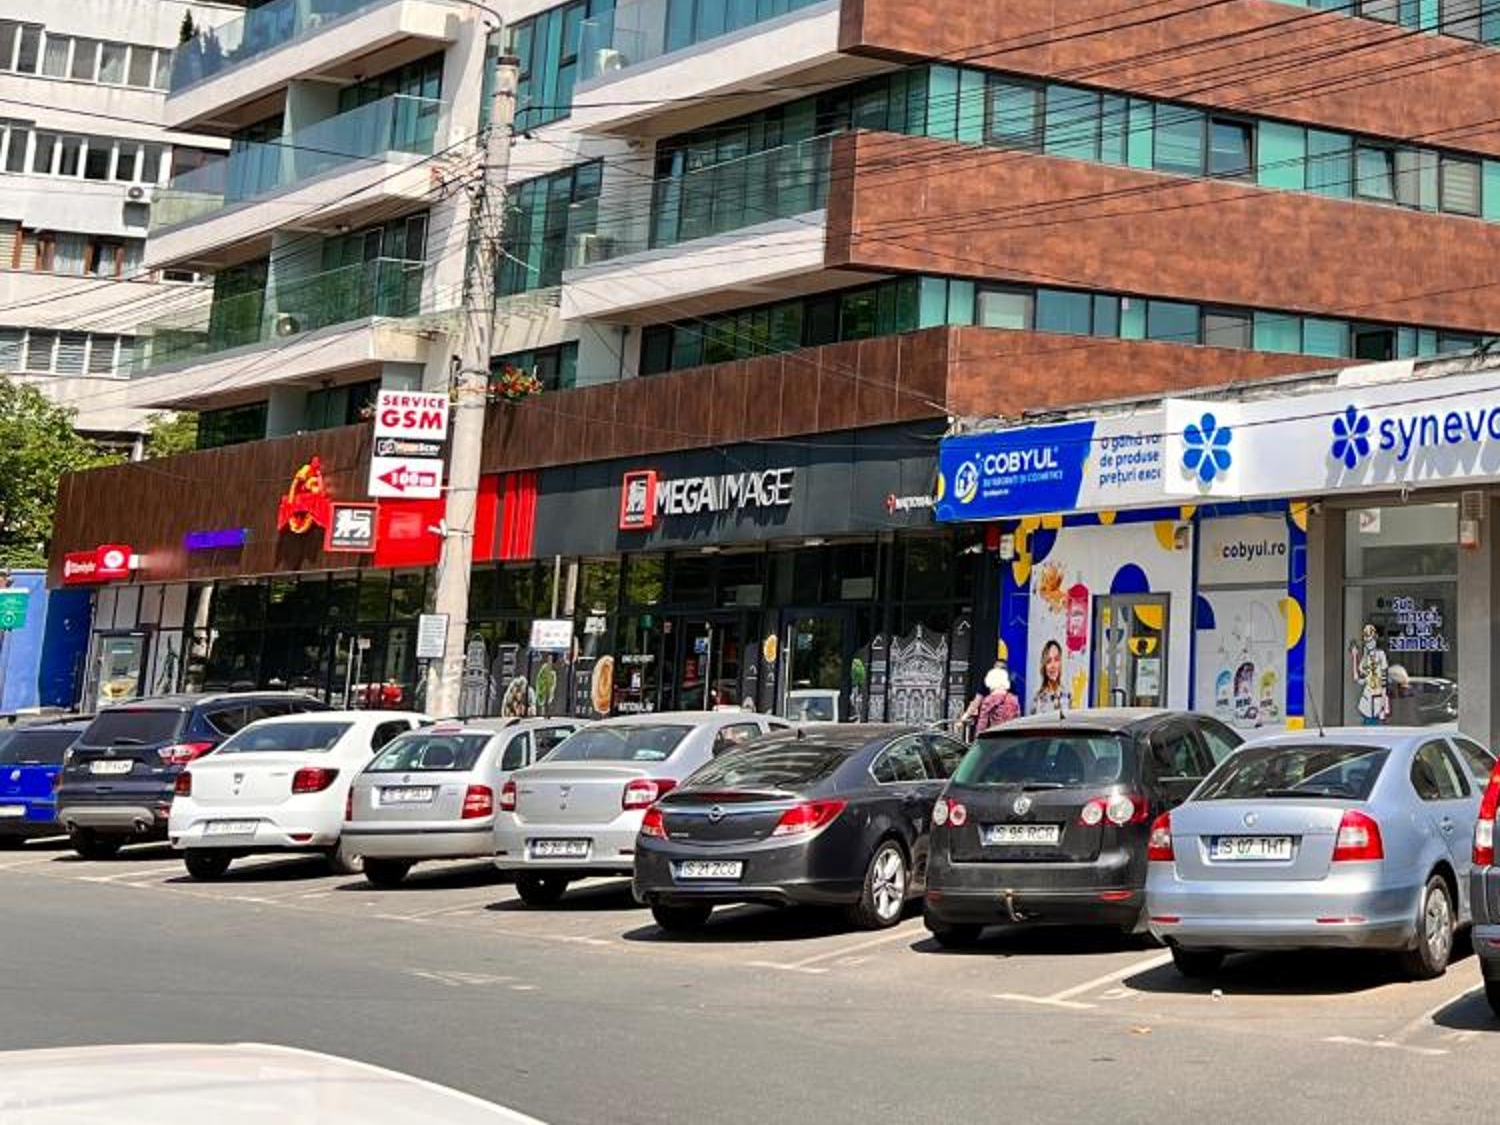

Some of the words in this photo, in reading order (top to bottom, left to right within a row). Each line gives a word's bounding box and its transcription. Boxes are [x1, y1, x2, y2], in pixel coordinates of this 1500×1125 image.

[383, 395, 446, 409] SERVICE
[381, 410, 443, 430] GSM
[984, 447, 1057, 475] COBYUL
[1100, 454, 1113, 467] de
[1116, 449, 1159, 470] produse
[1222, 540, 1287, 561] cobyul.ro
